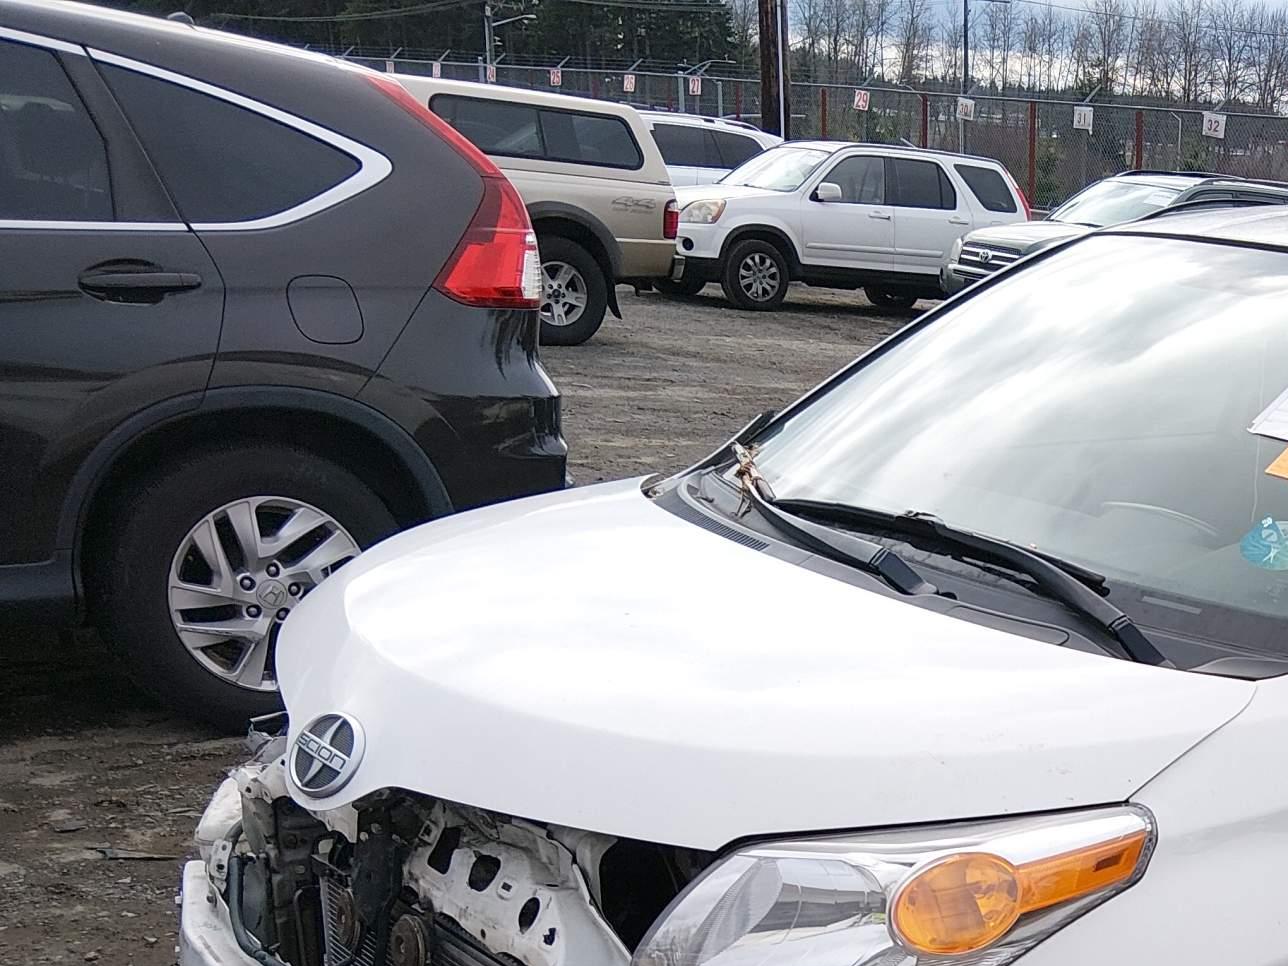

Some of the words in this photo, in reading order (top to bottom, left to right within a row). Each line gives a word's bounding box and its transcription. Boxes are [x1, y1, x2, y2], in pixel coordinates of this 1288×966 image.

[551, 70, 561, 85] 25
[624, 76, 634, 91] 26
[690, 78, 701, 94] 27
[855, 92, 869, 108] 29
[1077, 112, 1087, 125] 31
[1207, 119, 1220, 132] 32
[298, 733, 347, 770] SCION
